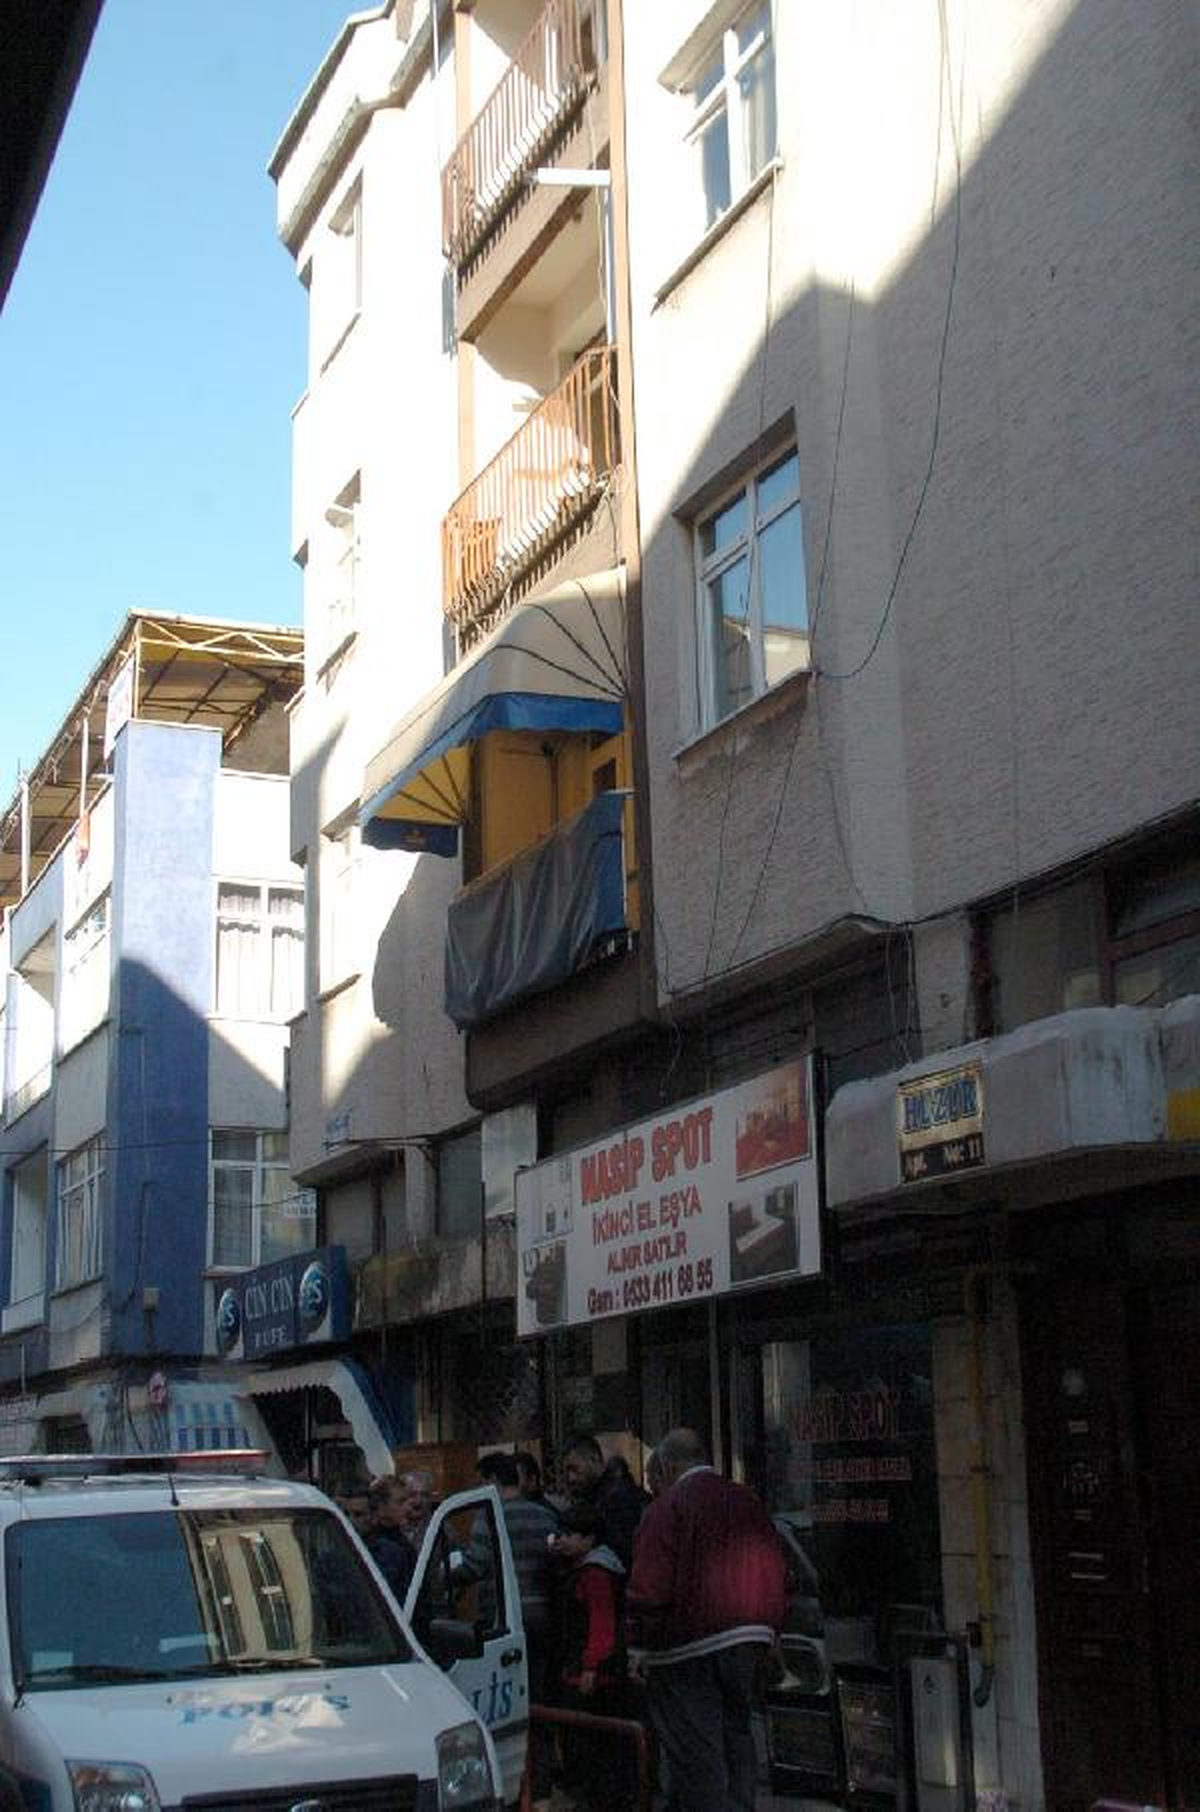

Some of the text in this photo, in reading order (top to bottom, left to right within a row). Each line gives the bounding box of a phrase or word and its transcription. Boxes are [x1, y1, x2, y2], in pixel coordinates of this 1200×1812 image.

[904, 1079, 977, 1134] HUZUR
[651, 1105, 713, 1182] SPOT
[592, 1184, 703, 1246] İKİNCİ EL EŞYA
[607, 1231, 687, 1275] ALINIR SATILIR
[652, 1267, 674, 1302] 411
